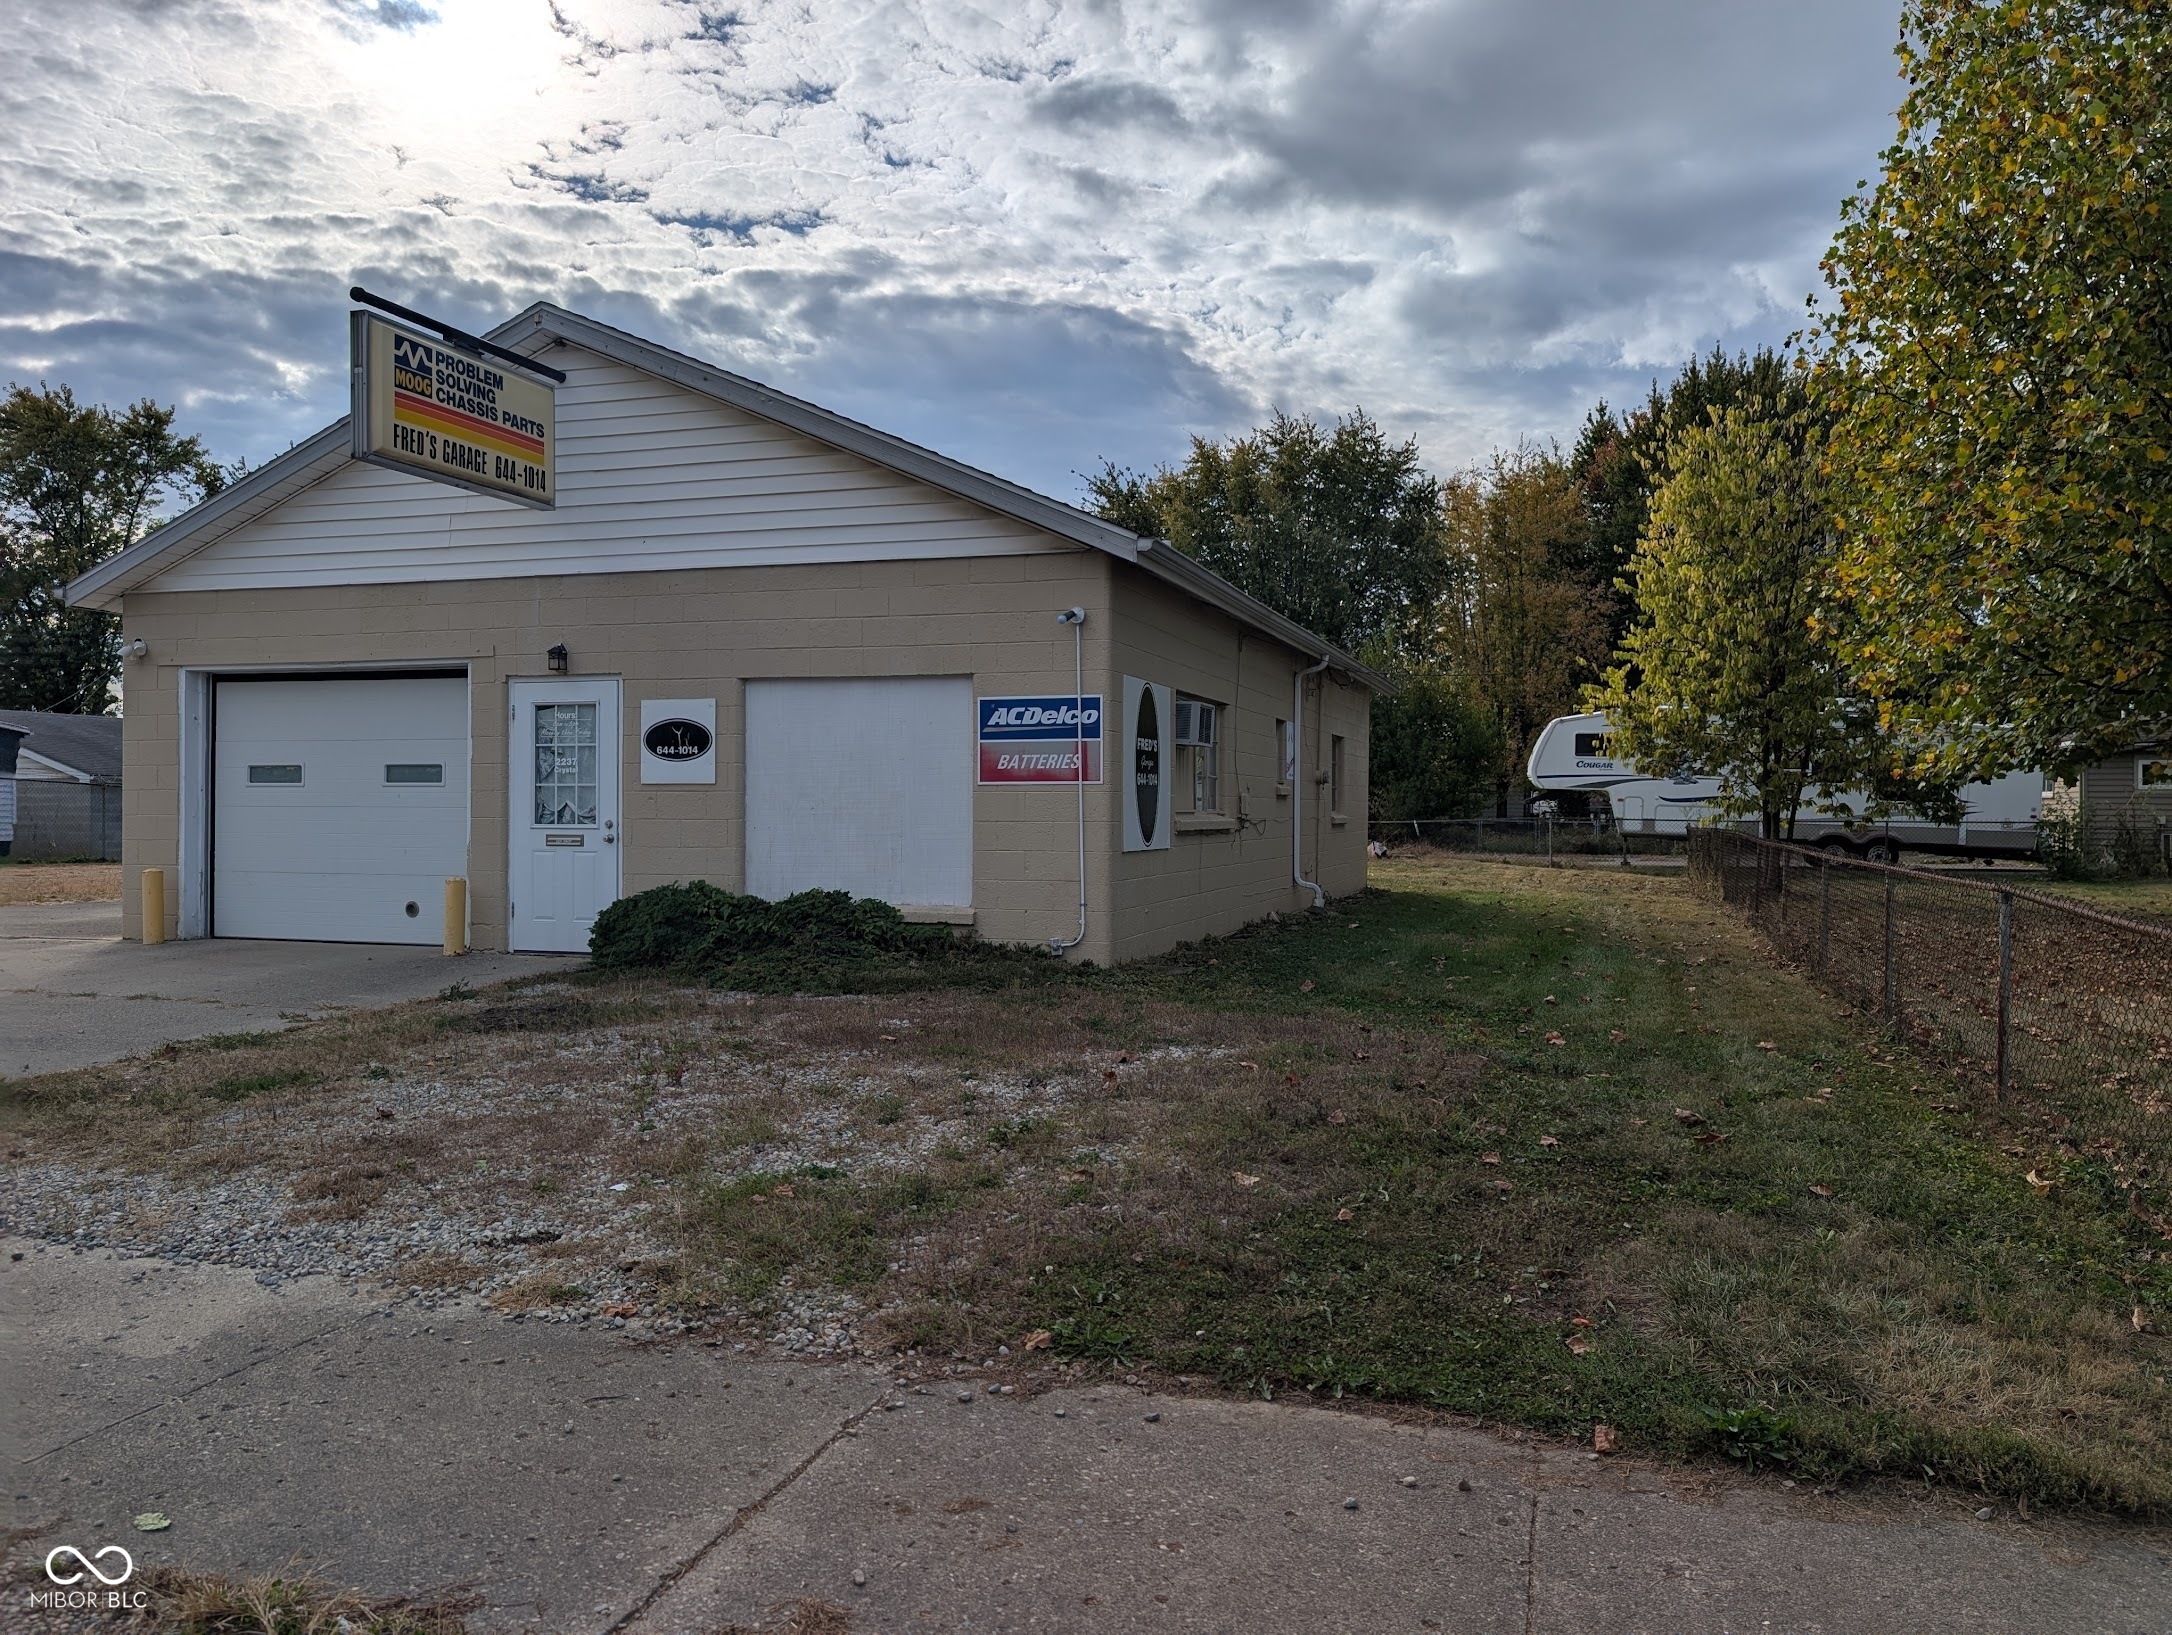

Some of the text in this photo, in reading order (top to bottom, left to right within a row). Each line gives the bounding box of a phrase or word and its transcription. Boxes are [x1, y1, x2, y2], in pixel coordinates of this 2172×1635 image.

[395, 368, 432, 396] MOOG
[436, 351, 503, 391] PROBLEM
[436, 369, 496, 404] SOLVING
[436, 387, 545, 438] CHASSIS PARTS
[393, 424, 546, 492] FRED'S GARAGE 644-1014
[987, 705, 1099, 726] ACDelco
[656, 745, 699, 755] 644-1014
[1137, 737, 1158, 752] FRED'S
[555, 757, 577, 766] 2237
[997, 753, 1081, 770] BATTERIES
